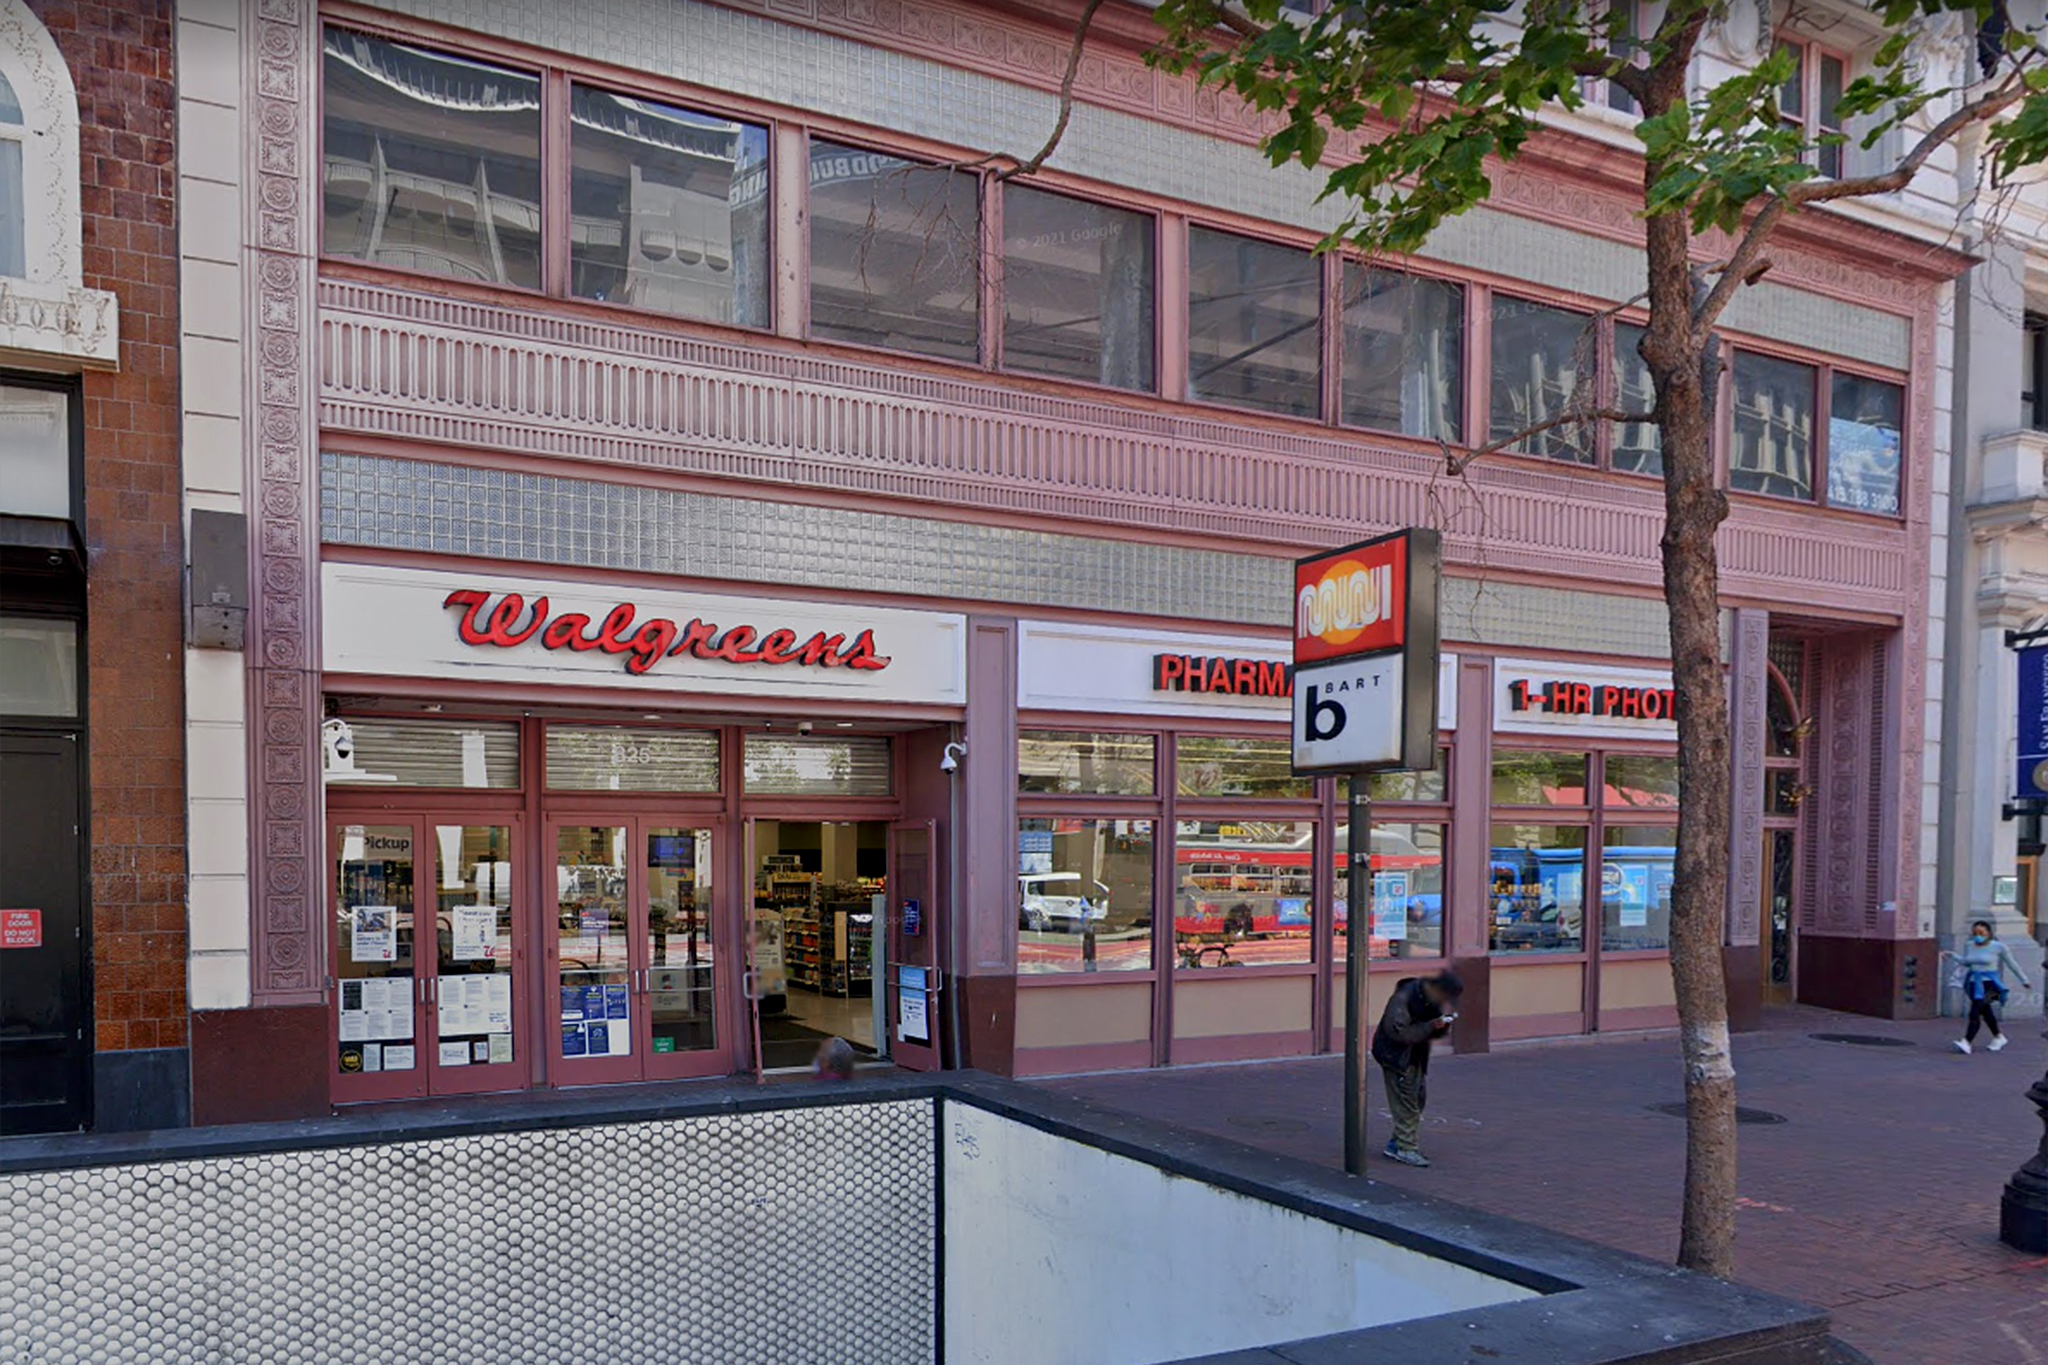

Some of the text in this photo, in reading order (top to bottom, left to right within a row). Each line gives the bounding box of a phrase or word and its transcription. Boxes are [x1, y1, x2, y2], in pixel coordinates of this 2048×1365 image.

[443, 590, 891, 674] Walgreens
[1154, 654, 1293, 697] PHARM
[1325, 675, 1381, 693] BART
[1305, 685, 1347, 742] b
[1509, 680, 1591, 714] 1-HR
[613, 746, 651, 764] 825
[19, 929, 36, 938] NOT
